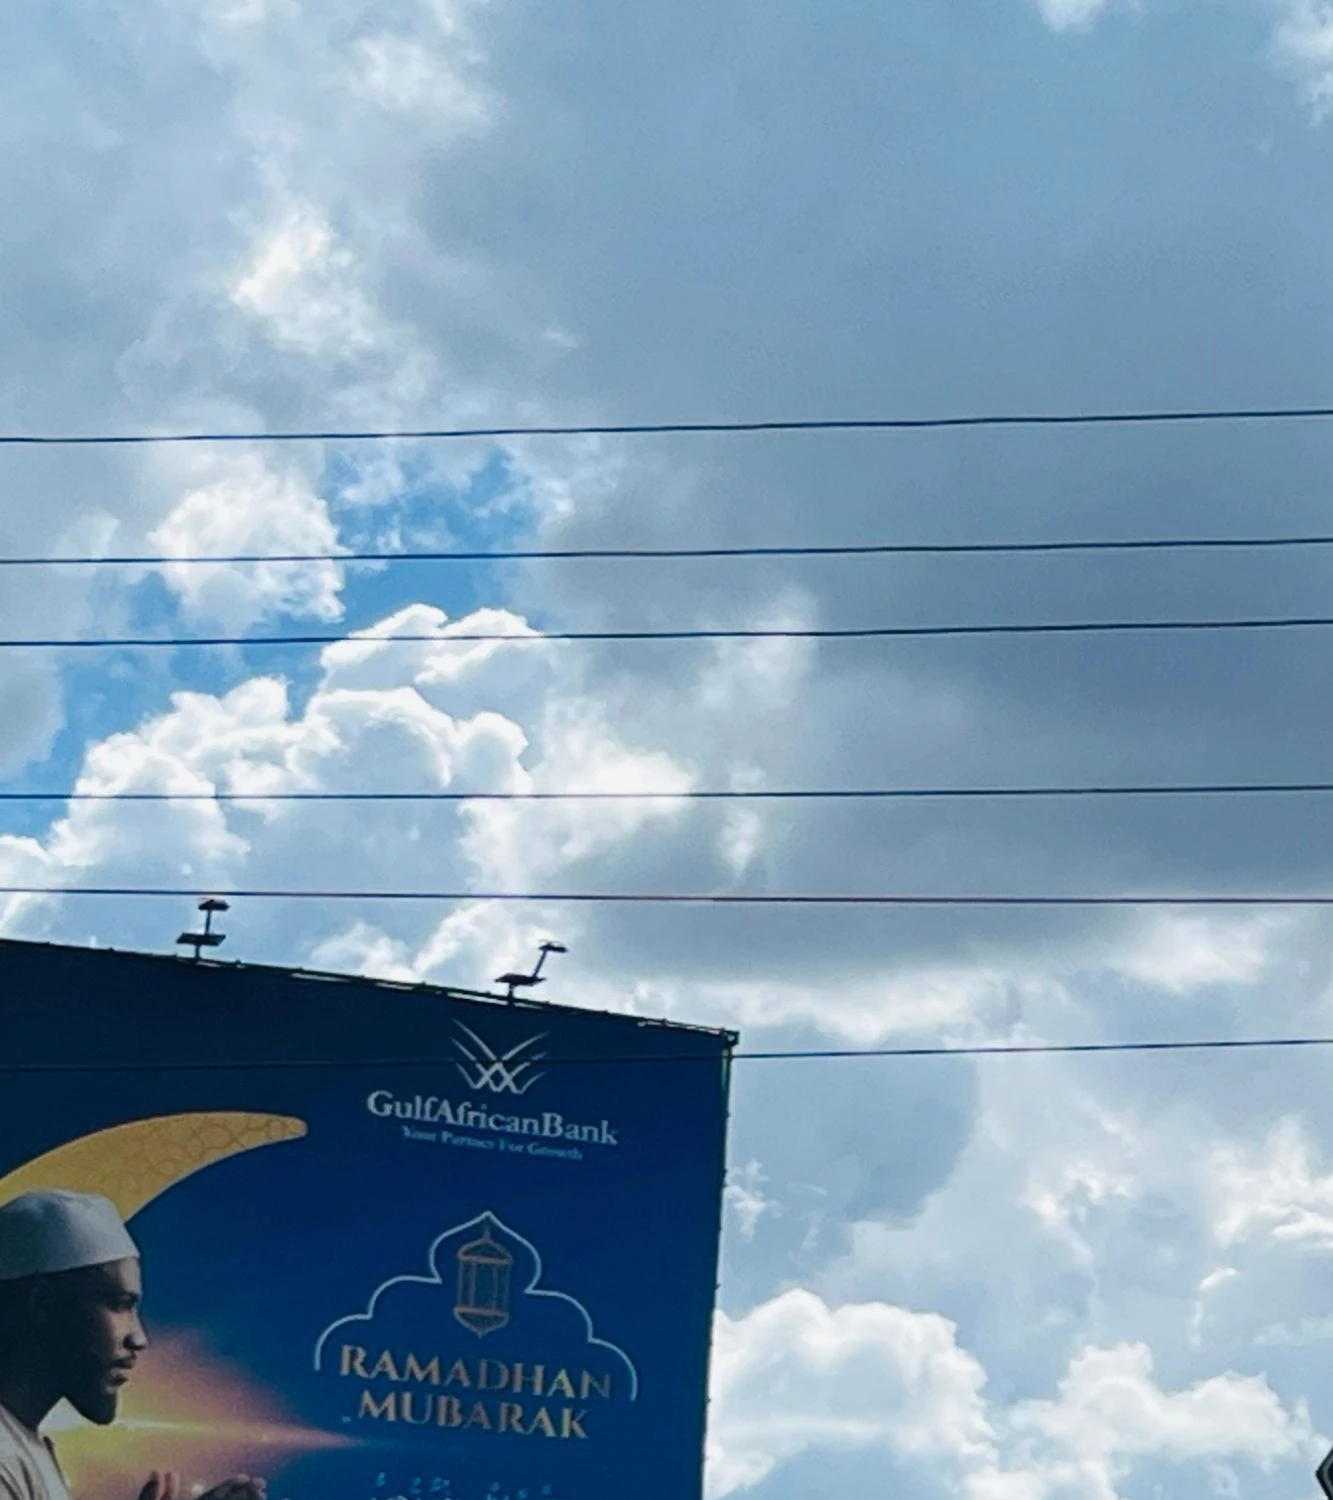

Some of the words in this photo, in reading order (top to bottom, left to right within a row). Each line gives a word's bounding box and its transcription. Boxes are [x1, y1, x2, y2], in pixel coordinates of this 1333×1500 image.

[367, 1090, 618, 1145] GulfAfricanBank
[340, 1345, 611, 1399] RAMADHAN
[358, 1389, 589, 1440] MUBARAK
